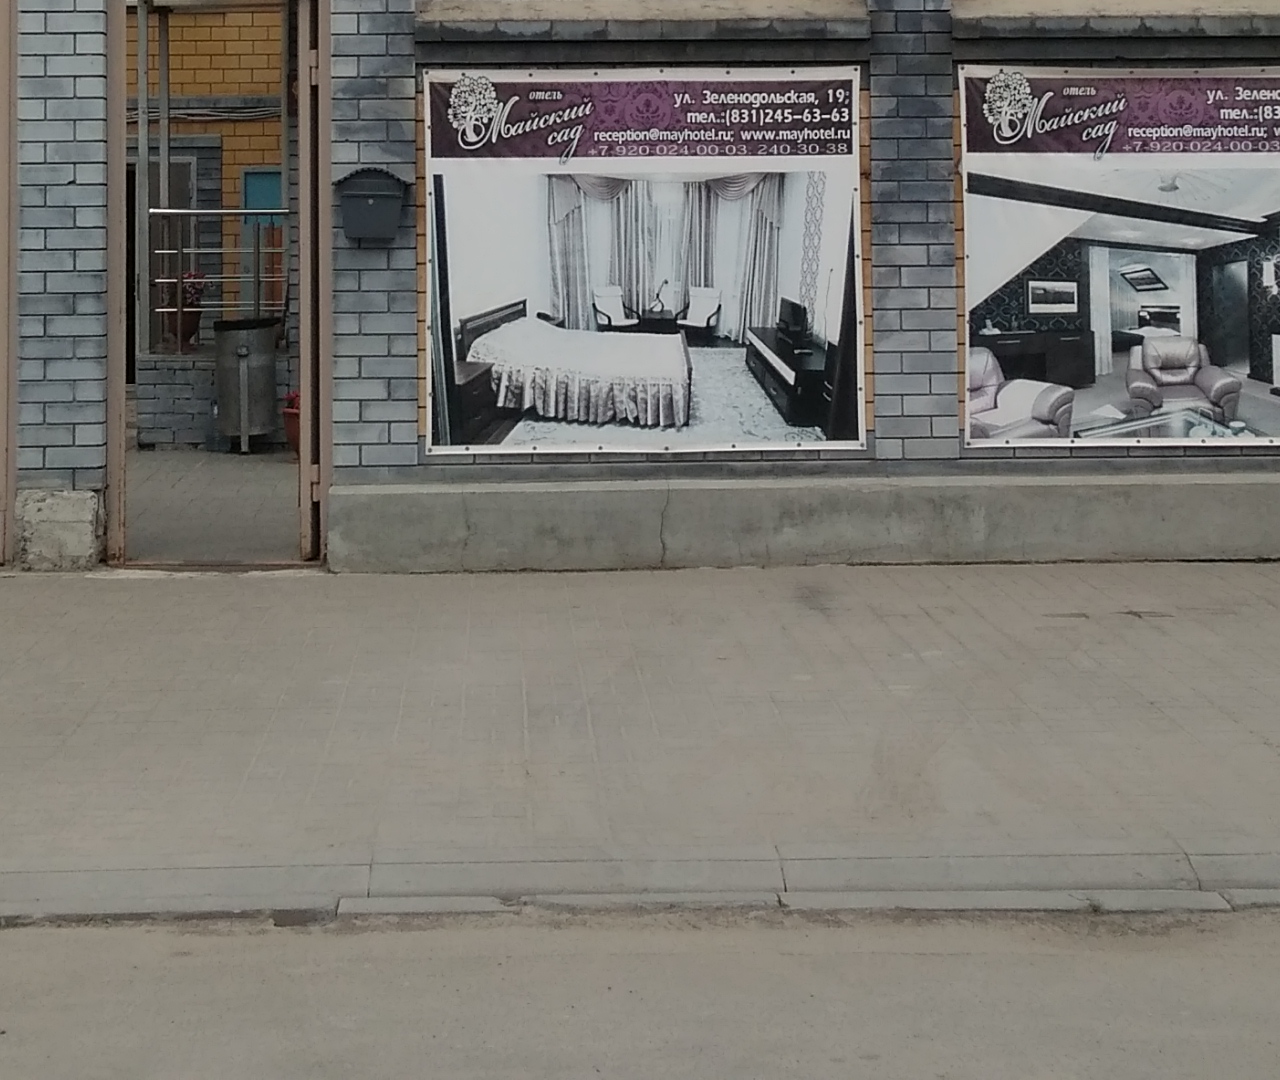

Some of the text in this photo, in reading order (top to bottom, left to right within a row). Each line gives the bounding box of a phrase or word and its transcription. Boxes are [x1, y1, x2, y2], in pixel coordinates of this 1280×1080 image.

[529, 90, 563, 100] отель
[674, 89, 850, 108] ул. Зеленодольская, 19;
[1063, 86, 1097, 96] отель
[1207, 88, 1229, 104] ул.
[483, 96, 595, 144] Майский
[1022, 91, 1129, 139] Майский
[593, 126, 851, 144] reception@mayhotel.ru; www.mayhotel.ru
[1082, 120, 1119, 161] сад
[1127, 124, 1268, 140] reception@mayhotel.ru;
[547, 124, 585, 165] сад
[757, 143, 848, 155] 240-30-38
